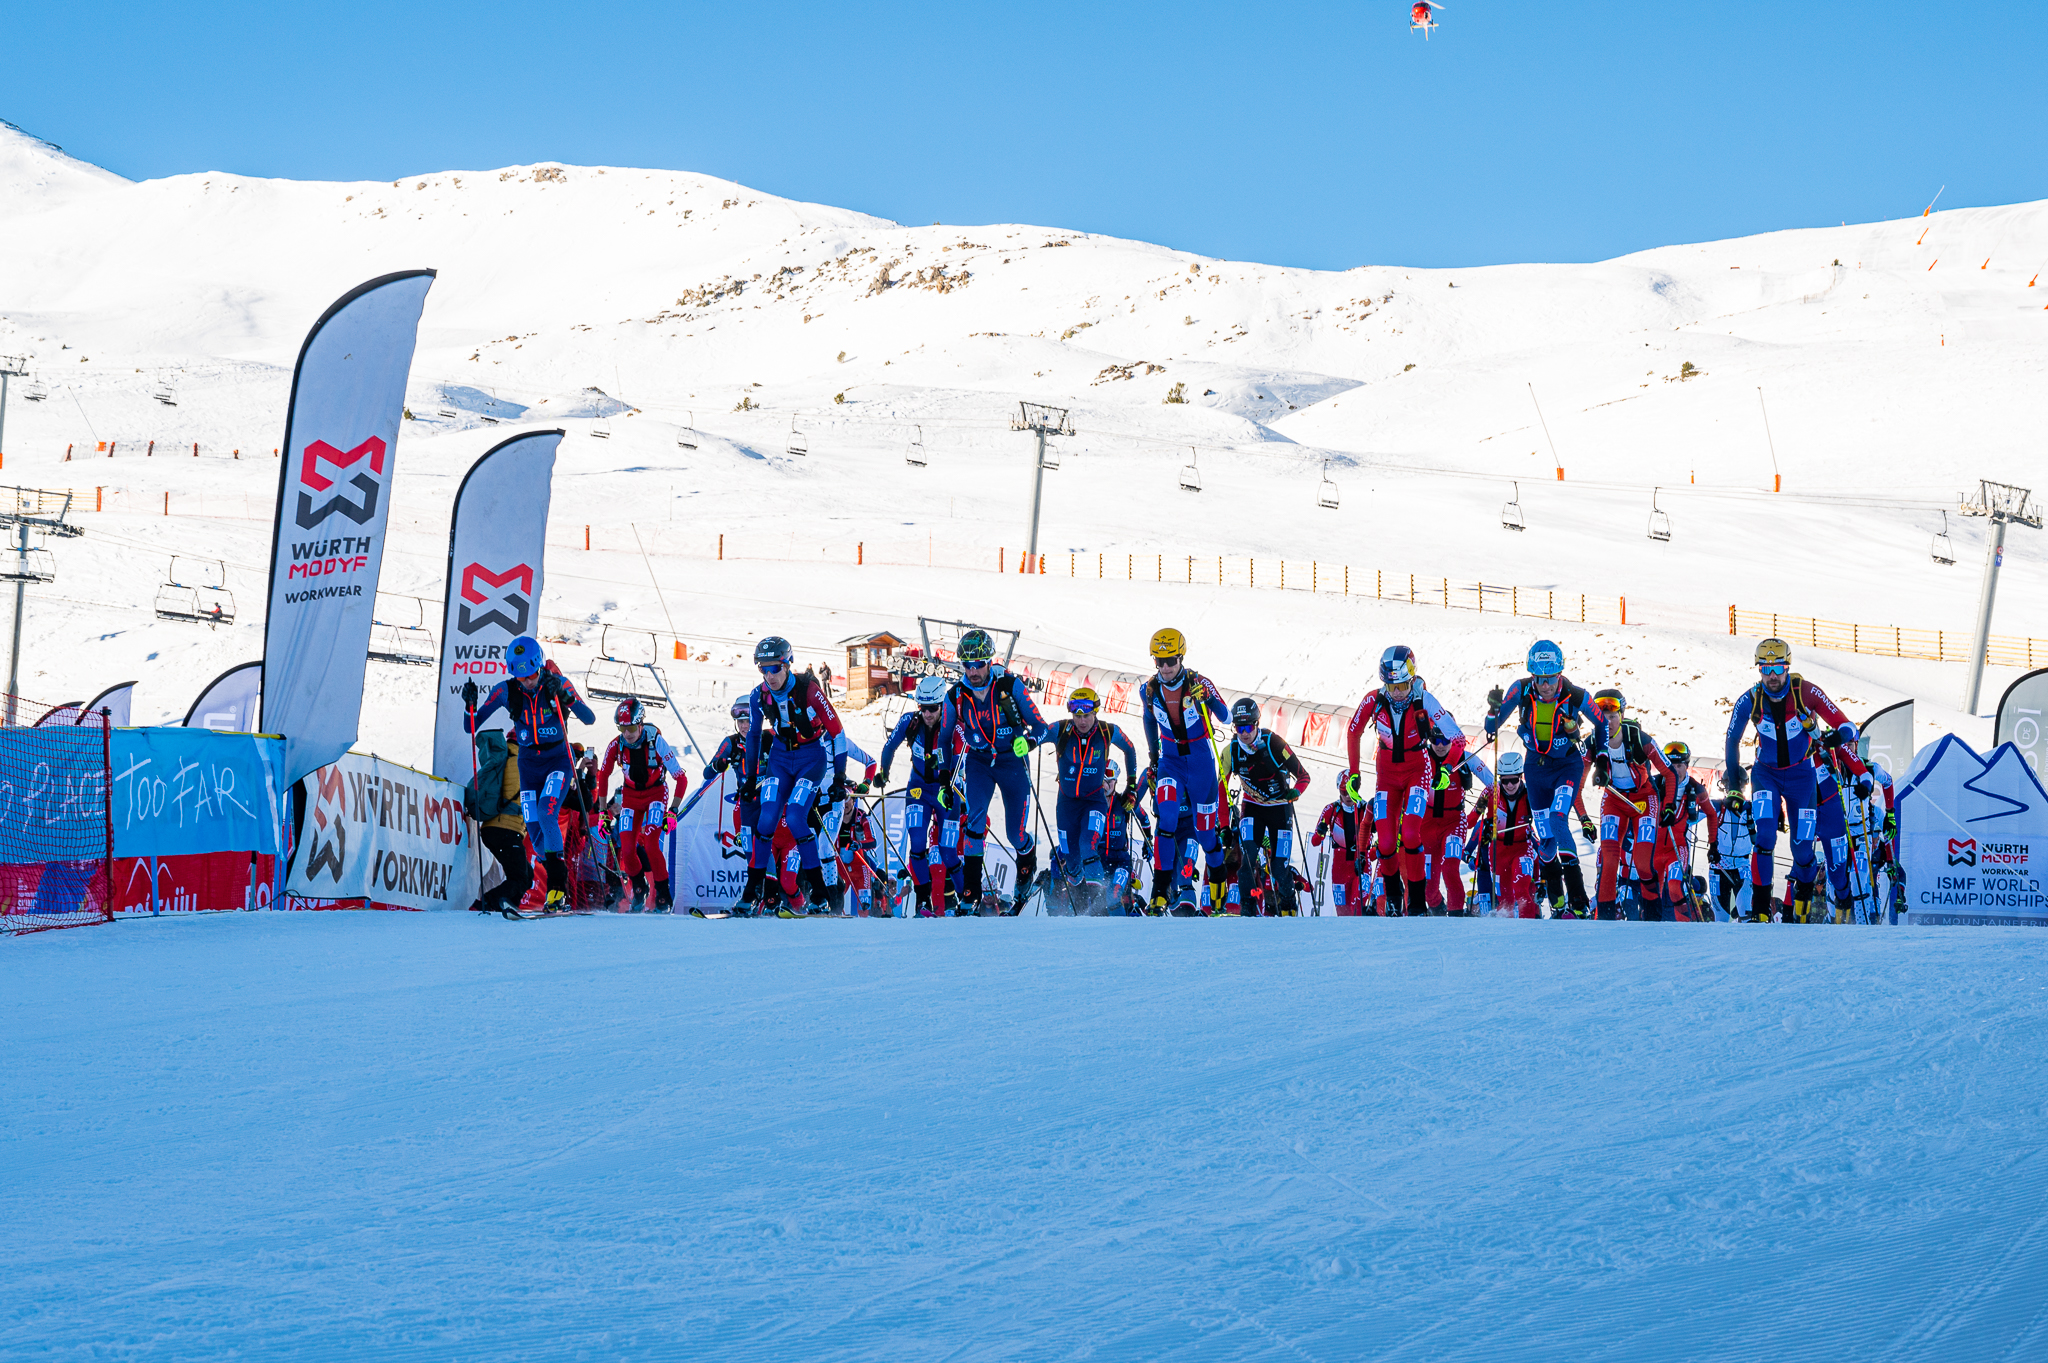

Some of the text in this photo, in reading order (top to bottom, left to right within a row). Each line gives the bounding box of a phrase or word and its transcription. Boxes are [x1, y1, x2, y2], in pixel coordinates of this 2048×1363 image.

[291, 536, 372, 561] WÜRTH
[288, 555, 368, 580] MODYF
[285, 585, 362, 604] WORKWEAR
[454, 645, 508, 660] WÜRT
[452, 661, 508, 675] MODY
[814, 690, 836, 721] FRANCE
[1810, 686, 1838, 715] FRANCE
[115, 752, 168, 830] TOO
[545, 780, 554, 795] 6
[764, 786, 771, 801] 4
[1163, 786, 1169, 801] 1
[793, 791, 803, 803] 4
[1554, 795, 1564, 811] 5
[523, 802, 530, 821] 6
[1413, 797, 1421, 813] 3
[1757, 800, 1765, 817] 7
[621, 816, 629, 830] 19
[649, 809, 661, 823] 19
[908, 813, 919, 826] 11
[1204, 815, 1210, 830] 1
[1095, 818, 1101, 831] 9
[1537, 821, 1547, 839] 5
[1603, 824, 1615, 839] 12
[1805, 820, 1813, 839] 7
[944, 831, 956, 845] 11
[1241, 826, 1247, 840] 8
[1640, 826, 1653, 841] 12
[1283, 840, 1289, 856] 8
[1449, 842, 1460, 857] 10
[1836, 846, 1847, 862] 14
[1981, 843, 2029, 854] WÜRTH
[789, 857, 801, 871] 24
[929, 852, 940, 864] 23
[1981, 855, 2029, 865] MODYF
[1670, 867, 1680, 879] 17
[1981, 868, 2029, 876] WORKWEAR
[1115, 874, 1127, 888] 27
[1937, 876, 2040, 892] ISMF WORLD
[1203, 894, 1211, 906] 31
[1334, 892, 1343, 905] 25
